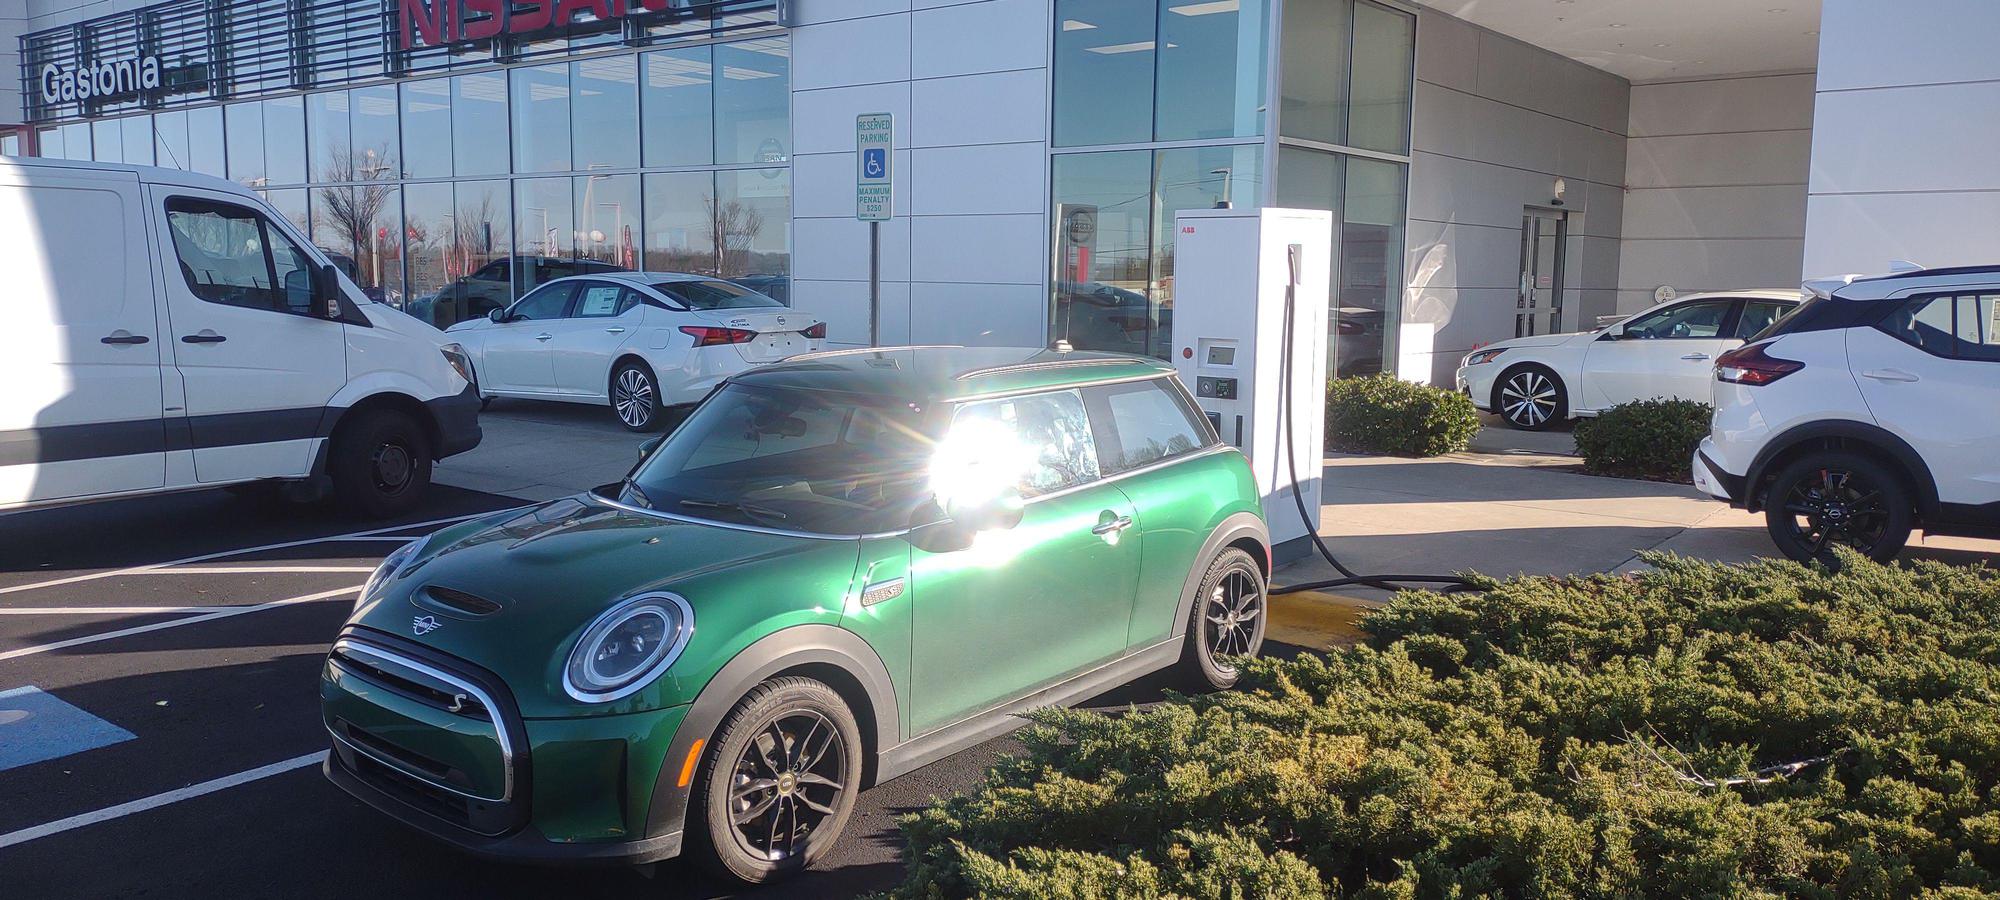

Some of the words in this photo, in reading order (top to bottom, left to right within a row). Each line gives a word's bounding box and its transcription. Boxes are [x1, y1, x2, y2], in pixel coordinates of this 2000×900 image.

[399, 0, 667, 49] NIS
[42, 50, 159, 103] Gastonia
[859, 120, 890, 131] RESERVED
[860, 133, 889, 143] PARKING
[859, 187, 890, 195] MAXIMUM
[859, 195, 890, 203] PENALTY
[866, 204, 882, 212] $250
[1182, 226, 1195, 234] ABB
